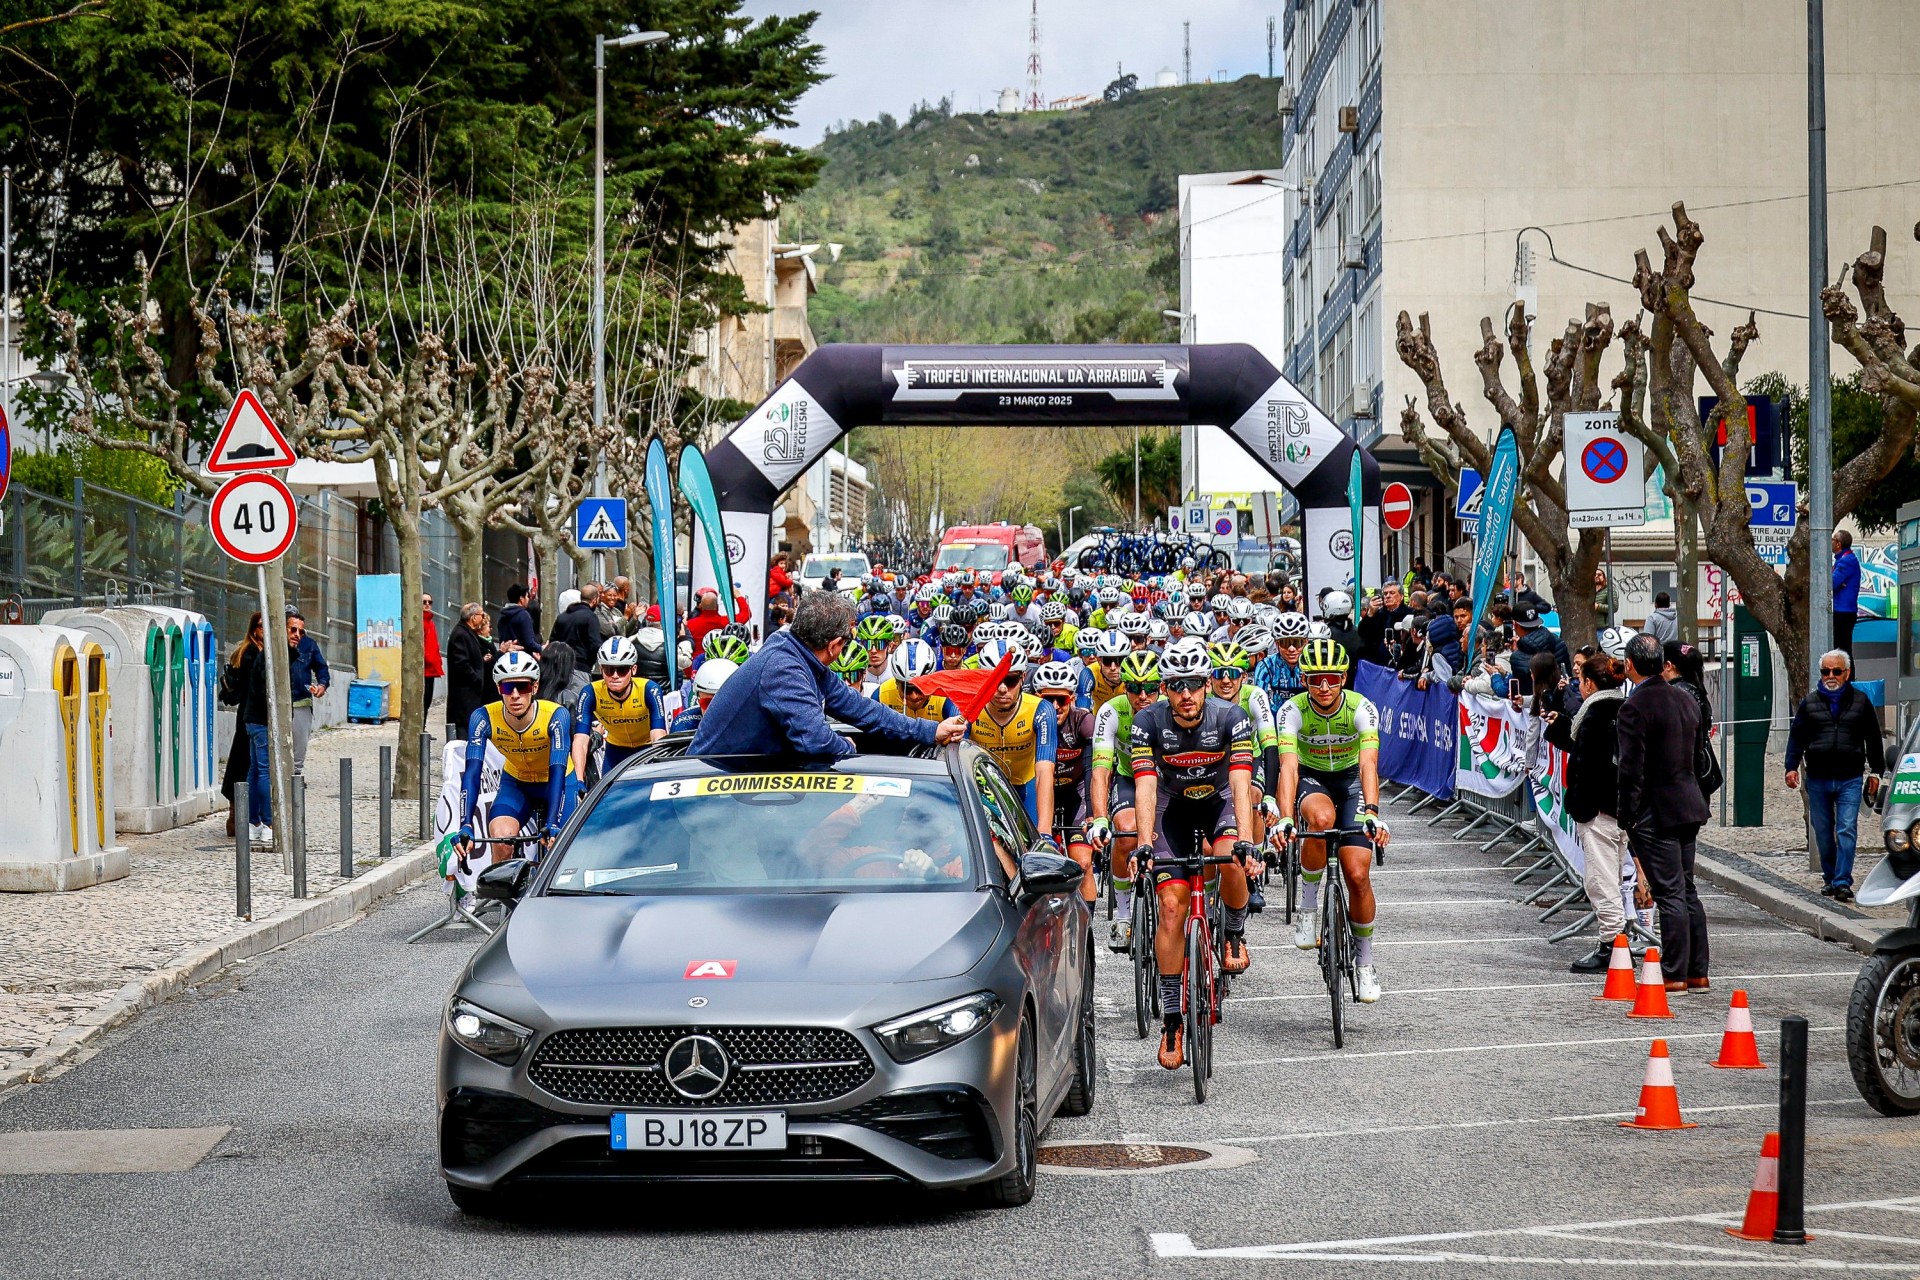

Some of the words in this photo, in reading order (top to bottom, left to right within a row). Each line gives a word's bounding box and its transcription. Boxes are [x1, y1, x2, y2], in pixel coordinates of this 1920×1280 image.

[924, 369, 969, 384] TROFÉU
[971, 369, 1064, 384] INTERNACIONAL
[1067, 369, 1085, 384] DA
[1087, 368, 1147, 384] ARRÁBIDA
[998, 396, 1011, 405] 23
[1013, 396, 1046, 408] MARÇO
[1048, 396, 1073, 405] 2025
[1267, 406, 1276, 418] DE
[799, 401, 808, 445] CICLISMO
[1267, 421, 1278, 462] CICLISMO
[797, 449, 805, 458] DE
[1497, 462, 1514, 506] SAÚDE
[233, 500, 275, 534] 40
[577, 693, 588, 714] CORTIZO
[1257, 695, 1269, 723] tavfer
[1097, 709, 1113, 737] tavfer
[1279, 704, 1293, 726] tavfer
[1365, 705, 1375, 727] tavfer
[1131, 725, 1149, 739] BH
[1231, 718, 1251, 736] BH
[69, 699, 78, 817] EMBALAGENS
[512, 745, 548, 753] CORTIZO
[669, 782, 681, 796] 3
[706, 777, 837, 792] COMMISSAIRE
[842, 778, 854, 790] 2
[689, 961, 728, 977] A
[616, 1135, 622, 1143] P
